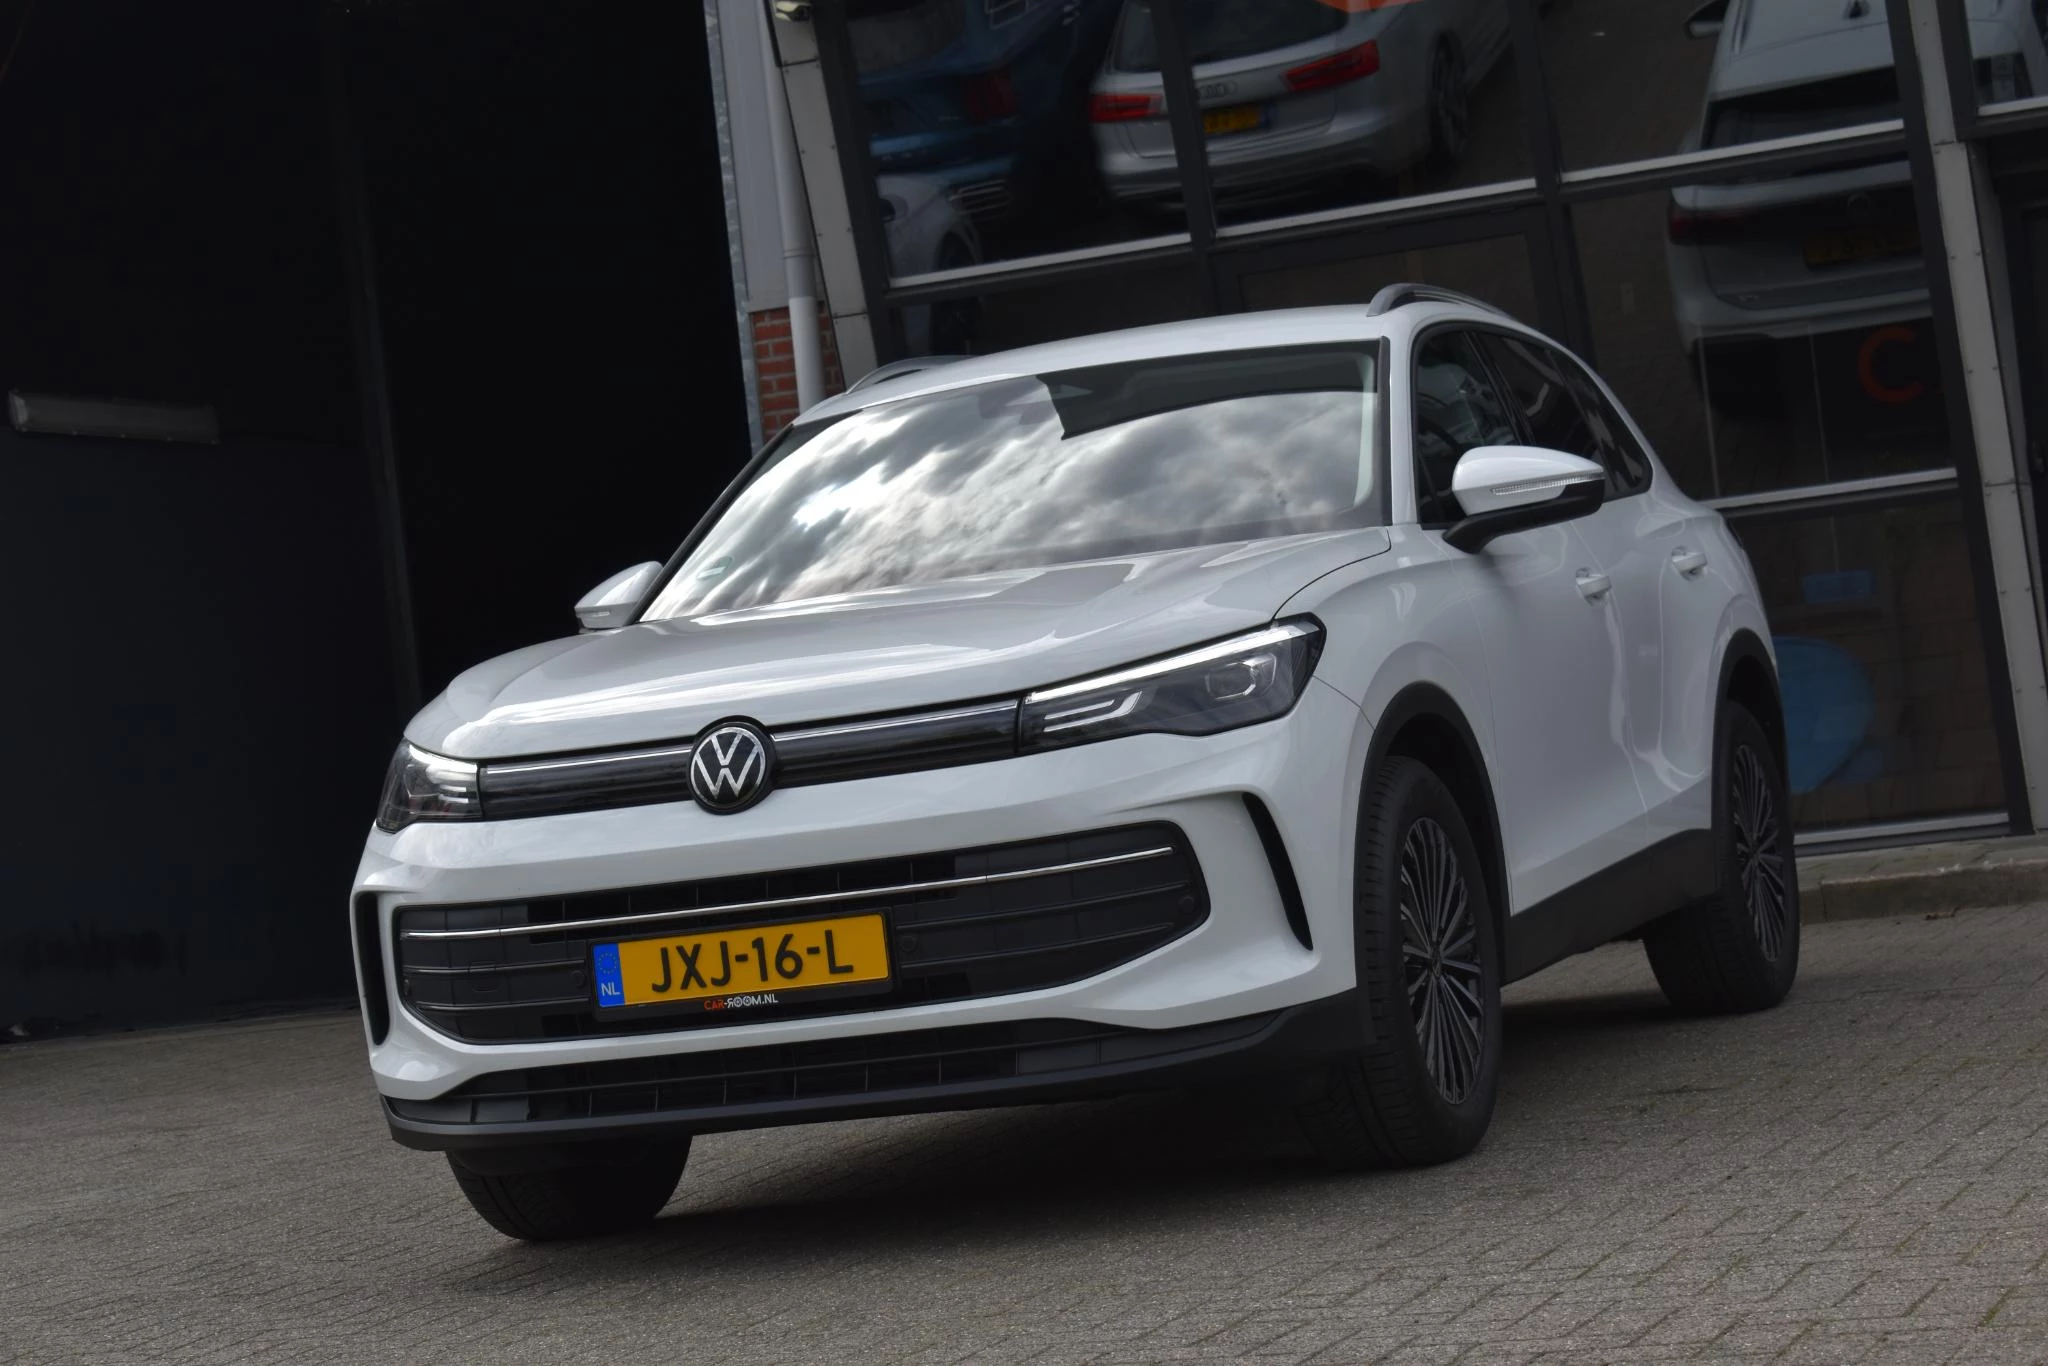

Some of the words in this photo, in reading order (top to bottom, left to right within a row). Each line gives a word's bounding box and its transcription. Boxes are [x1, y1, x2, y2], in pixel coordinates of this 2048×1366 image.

[1856, 324, 1928, 405] C
[691, 727, 765, 804] VW
[601, 981, 620, 997] NL
[651, 929, 854, 993] JXJ-16-L
